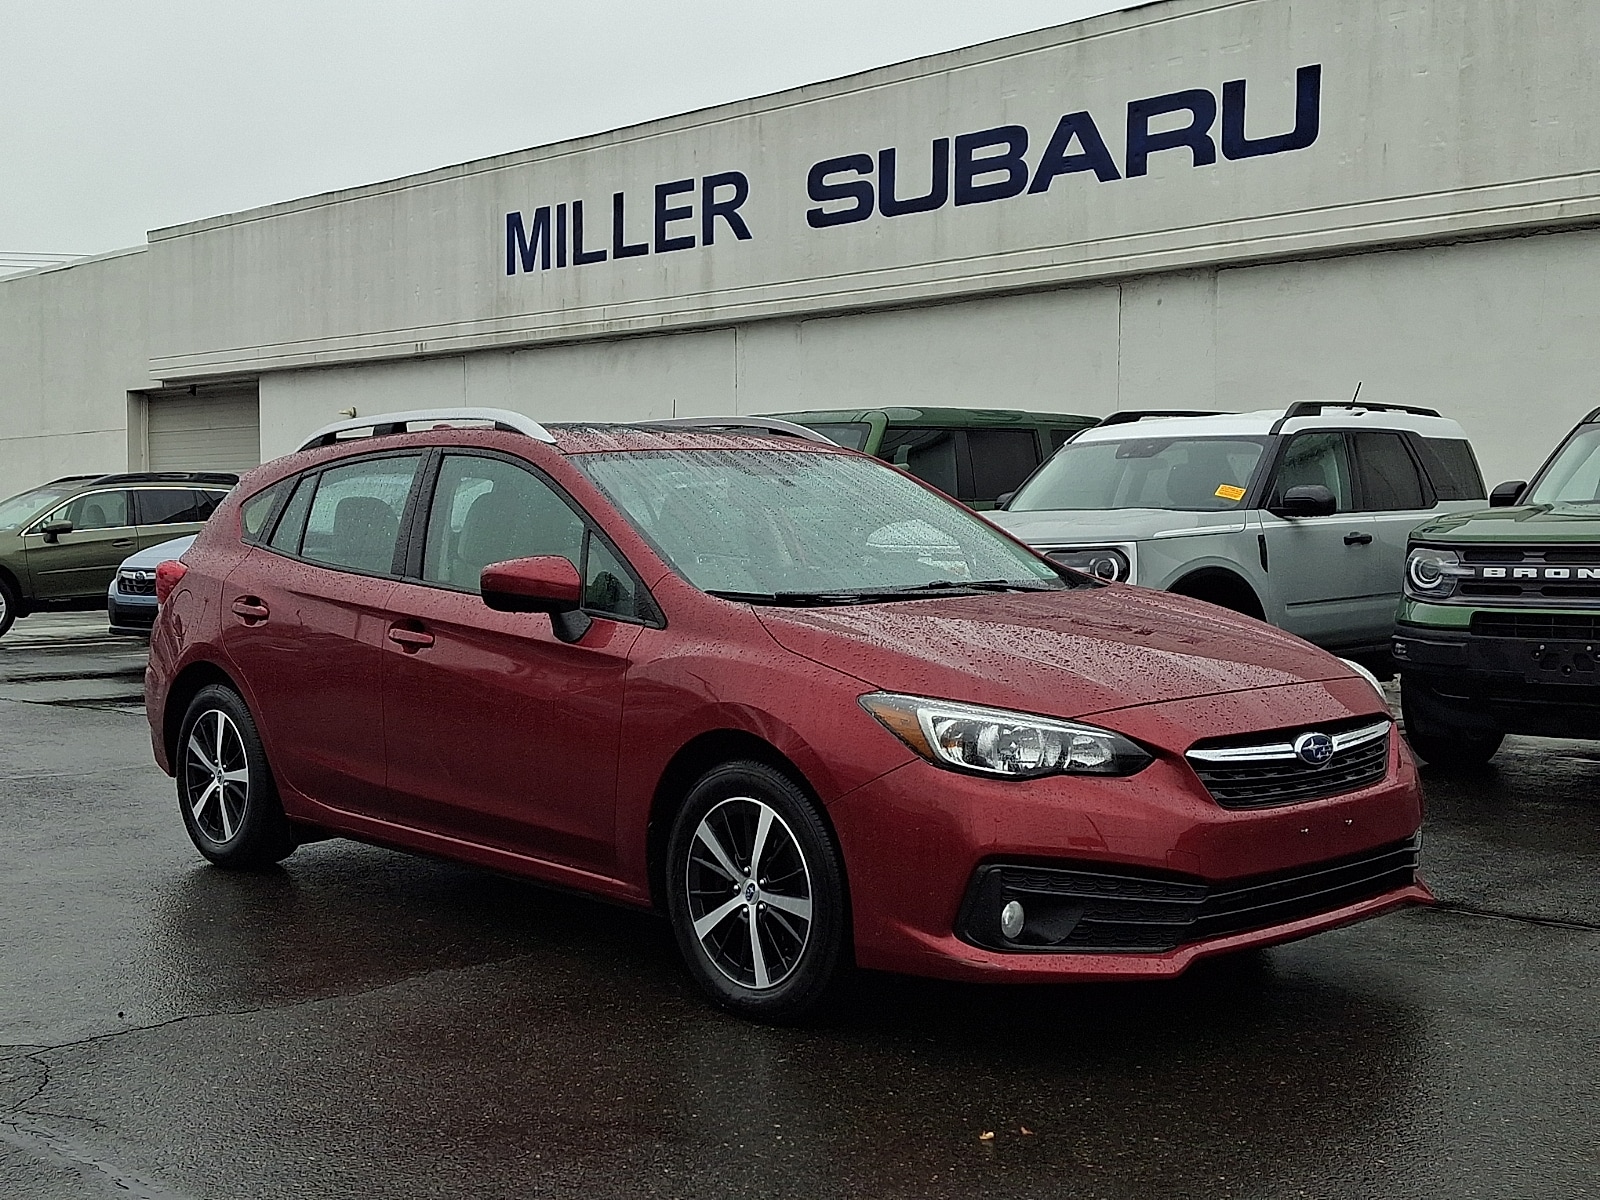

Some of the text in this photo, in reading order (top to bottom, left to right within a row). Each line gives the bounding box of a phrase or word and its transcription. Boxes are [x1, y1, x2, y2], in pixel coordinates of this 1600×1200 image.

[506, 63, 1322, 276] MILLER SUBARU
[1483, 567, 1600, 579] BRON
